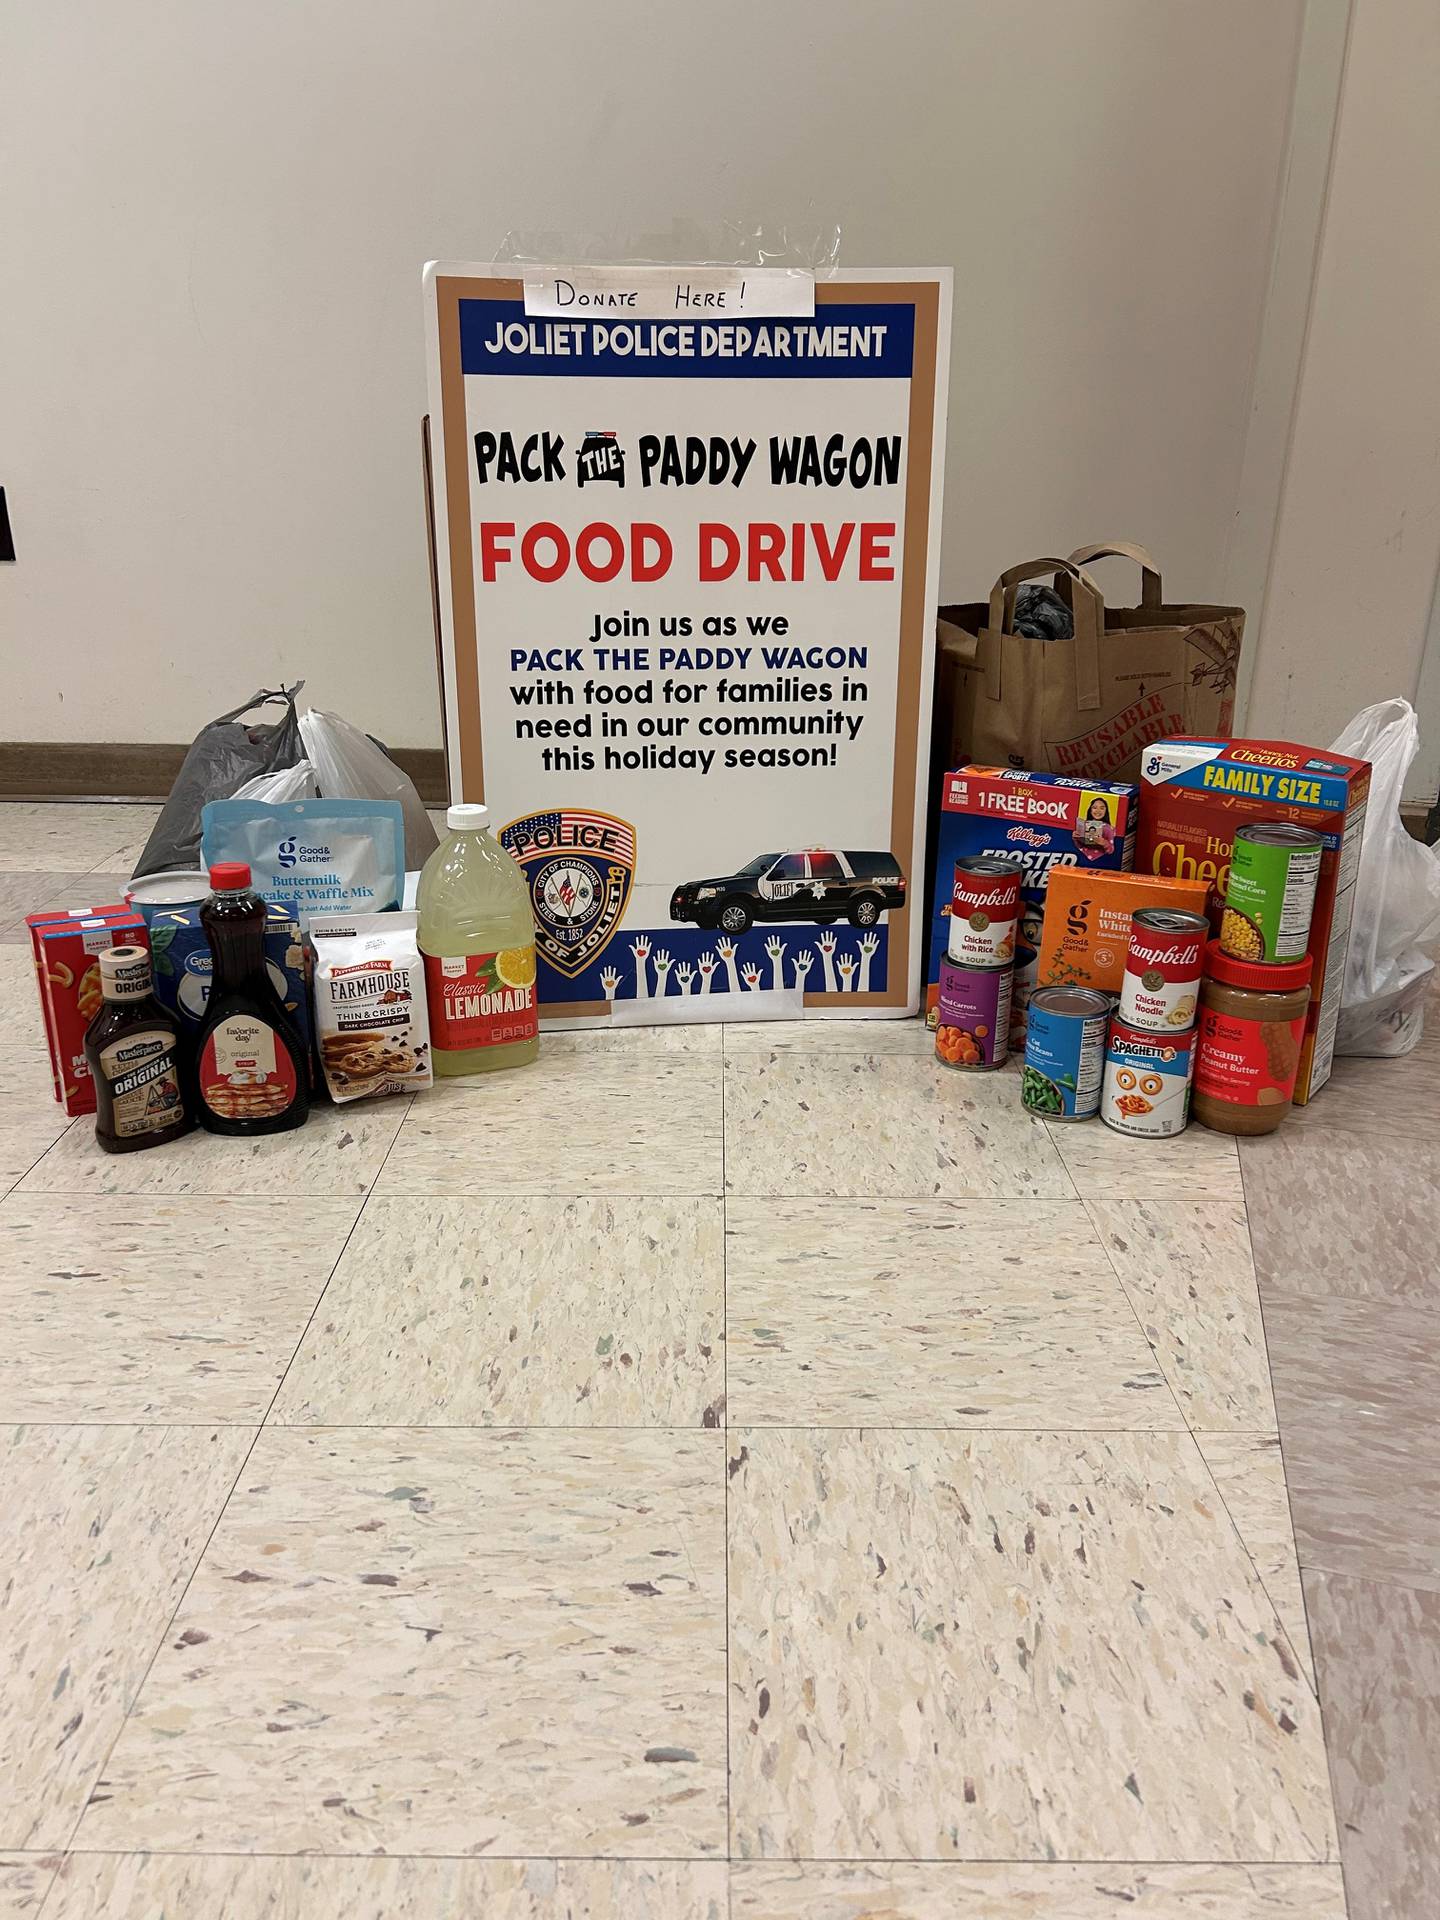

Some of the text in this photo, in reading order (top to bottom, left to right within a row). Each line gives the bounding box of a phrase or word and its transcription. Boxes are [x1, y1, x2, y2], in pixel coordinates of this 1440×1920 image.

[484, 322, 888, 358] JOLIET POLICE DEPARTMENT
[473, 430, 902, 490] PACK THE PADDY WAGON
[480, 521, 896, 583] FOOD DRIVE
[589, 610, 789, 642] Join us as we
[510, 646, 868, 671] PACK THE PADDY WAGON
[510, 676, 868, 705] with food for families in
[516, 709, 863, 740] need in our community
[1055, 692, 1166, 767] REUSABLE
[542, 743, 837, 774] this holiday season!
[1231, 749, 1298, 769] Cheerios
[1017, 788, 1033, 797] BOX
[1203, 765, 1322, 804] FAMILY SIZE
[978, 792, 1070, 820] 1 FREE BOOK
[1289, 808, 1300, 819] 12
[512, 824, 621, 857] POLICE
[1007, 826, 1051, 847] Kellogg's
[299, 855, 331, 863] Gather
[538, 861, 599, 888] CITY OF CHAMPIONS
[1153, 841, 1230, 896] Chee
[272, 874, 341, 887] Buttermilk
[872, 876, 899, 885] POLICE
[256, 885, 374, 901] ncake & Waffle Mix
[953, 880, 1016, 908] Campbell's
[1248, 886, 1266, 895] Corn
[539, 900, 599, 925] STEEL & STONE
[1099, 908, 1132, 921] Insta
[544, 884, 621, 958] OF JOLIET
[568, 928, 583, 941] 1852
[964, 935, 992, 944] Chicken
[961, 943, 994, 953] with Rice
[1062, 944, 1088, 953] Gather
[1128, 934, 1199, 965] Campbell's
[190, 957, 213, 966] Gre
[334, 960, 388, 976] PEPPERIDGE FARM
[966, 956, 986, 964] SOUP
[116, 980, 152, 993] ORIGIN
[330, 971, 410, 1000] FARMHOUSE
[444, 981, 485, 997] Classic
[445, 987, 533, 1020] LEMONADE
[953, 1001, 976, 1010] Carrots
[1135, 993, 1166, 1007] Chicken
[337, 1011, 362, 1021] THIN
[364, 1010, 371, 1018] &
[372, 1006, 409, 1018] CRISPY
[1135, 1003, 1164, 1016] Noodle
[360, 1020, 391, 1028] CHOCOLATE
[1136, 1018, 1158, 1027] SOUP
[226, 1027, 260, 1035] favorite
[235, 1034, 250, 1043] day
[1031, 1038, 1040, 1046] Cut
[119, 1042, 162, 1060] Masterpiece
[231, 1050, 260, 1058] original
[1035, 1047, 1053, 1057] Beans
[1202, 1042, 1246, 1064] Creamy
[1124, 1058, 1155, 1070] ORIGINAL
[1200, 1053, 1228, 1070] Peanut
[1230, 1063, 1259, 1075] Butter
[115, 1057, 173, 1095] ORIGINAL
